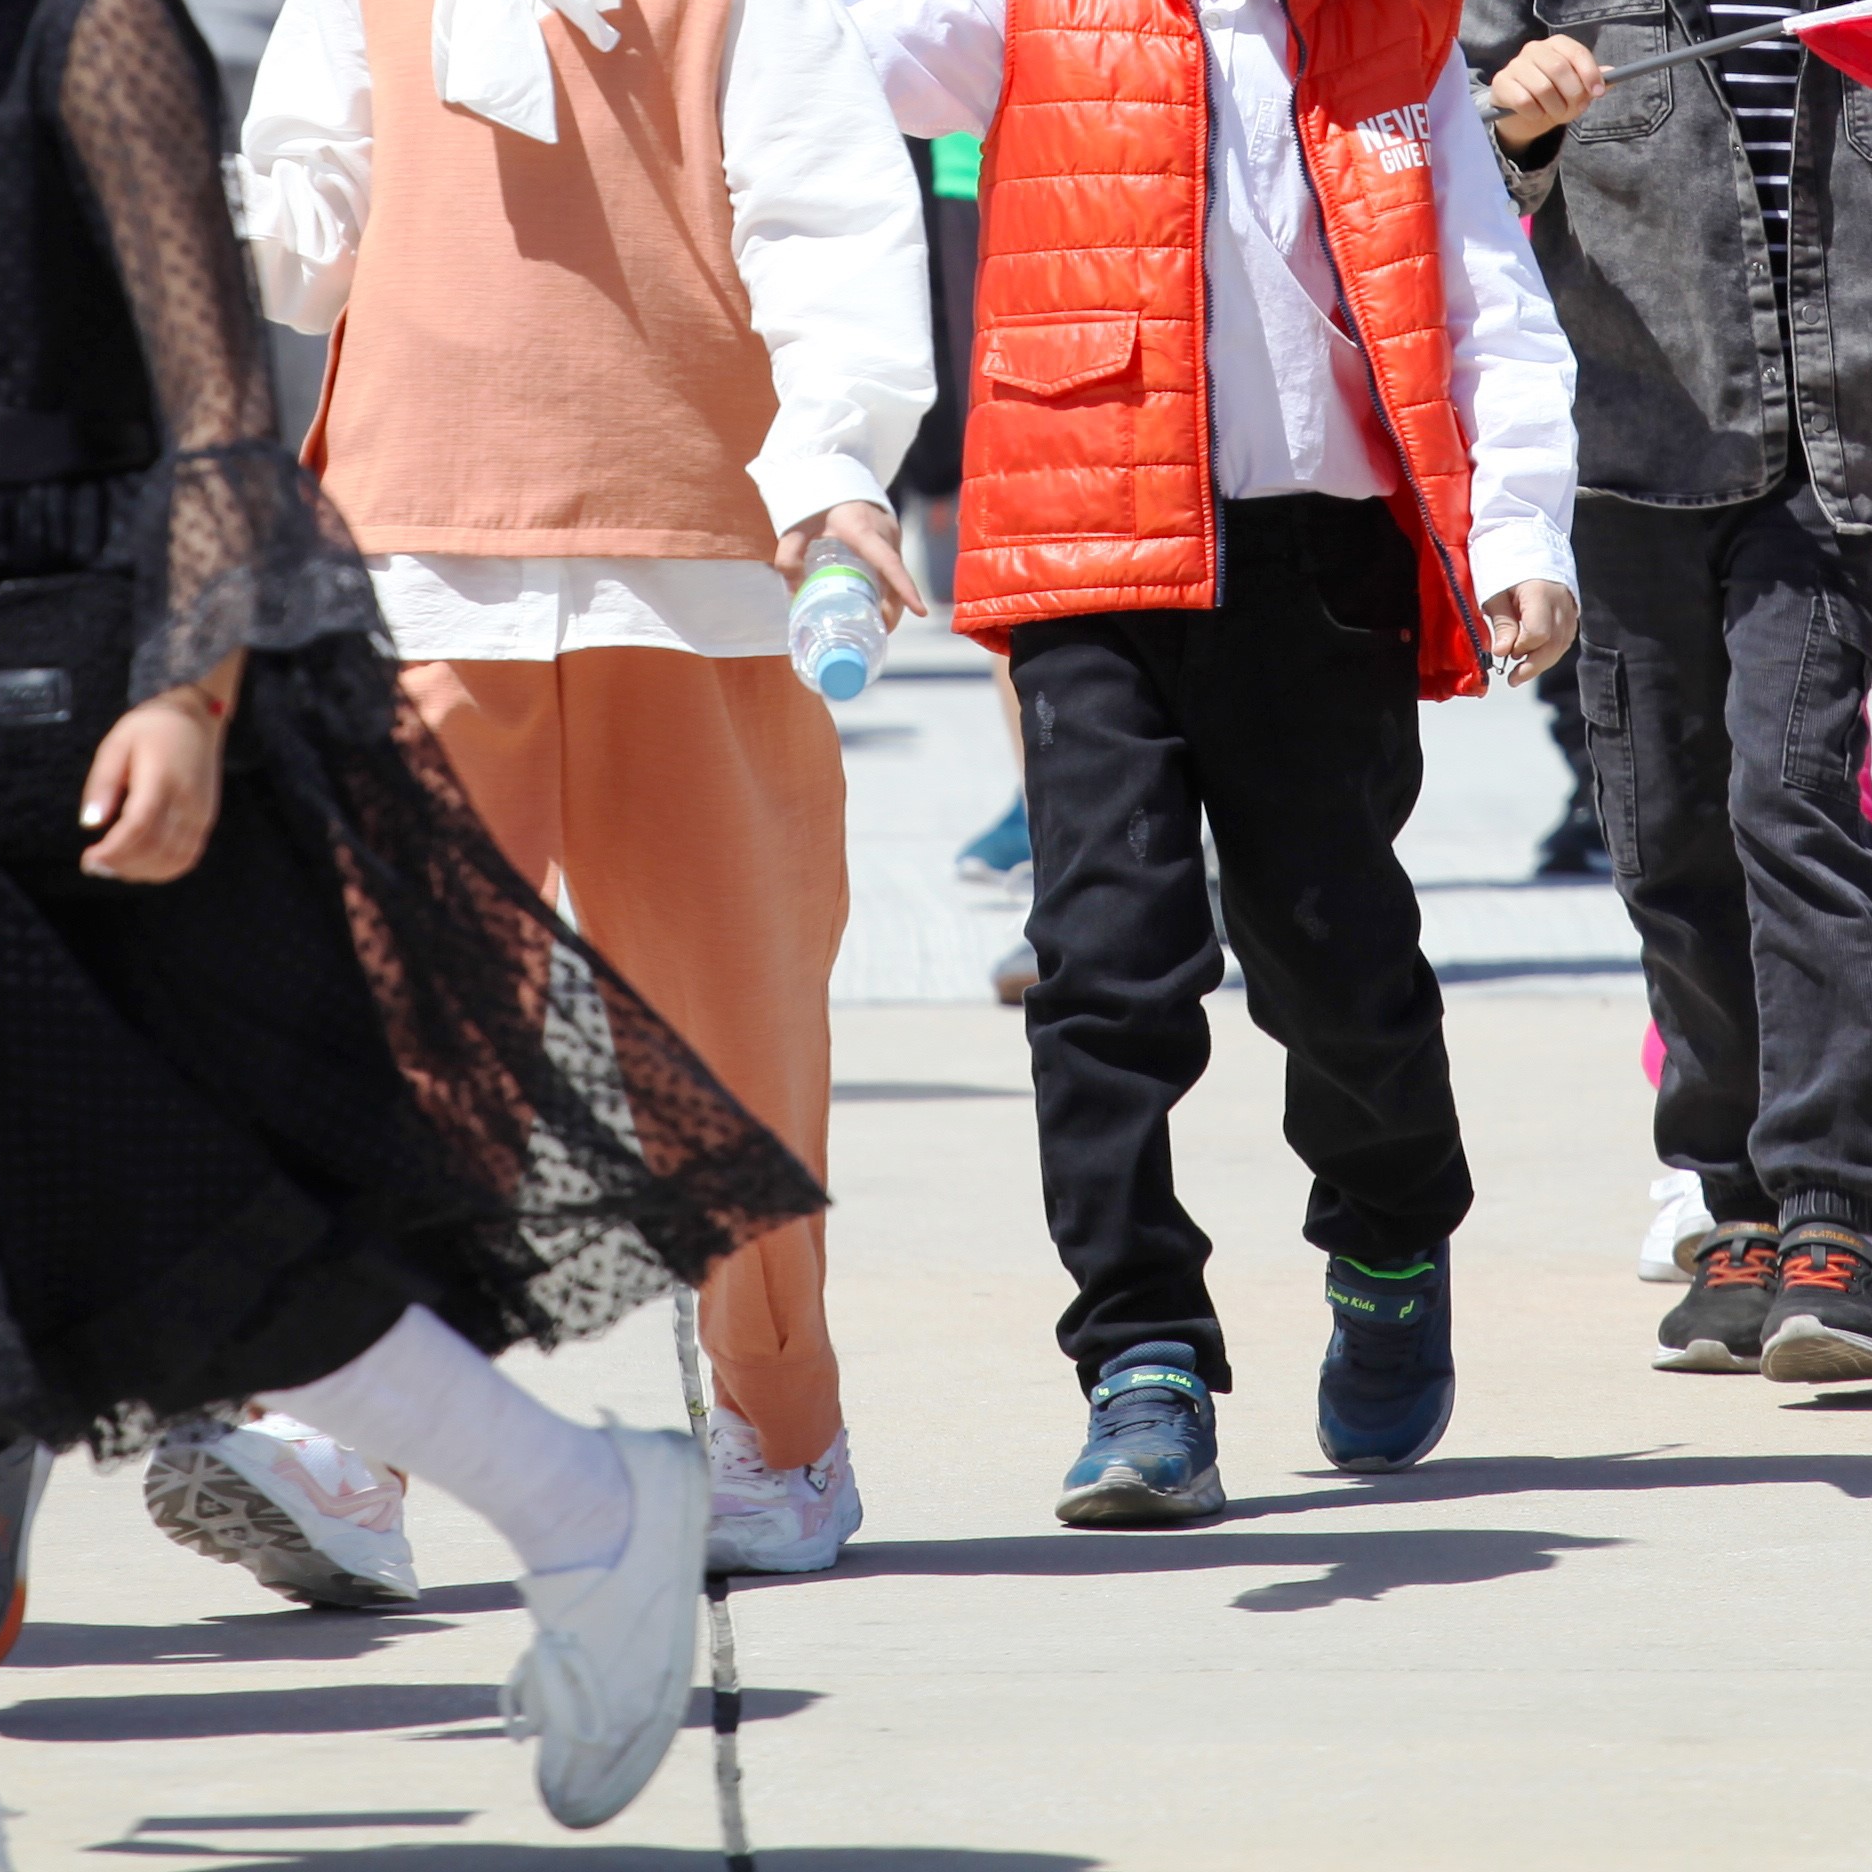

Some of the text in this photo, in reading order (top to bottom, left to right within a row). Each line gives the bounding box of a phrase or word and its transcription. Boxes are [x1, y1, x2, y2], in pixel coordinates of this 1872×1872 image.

[1355, 102, 1431, 154] NEVE
[1379, 142, 1424, 175] GIVE
[1328, 1285, 1376, 1312] Jump Kids
[1131, 1373, 1193, 1388] Jump Kids
